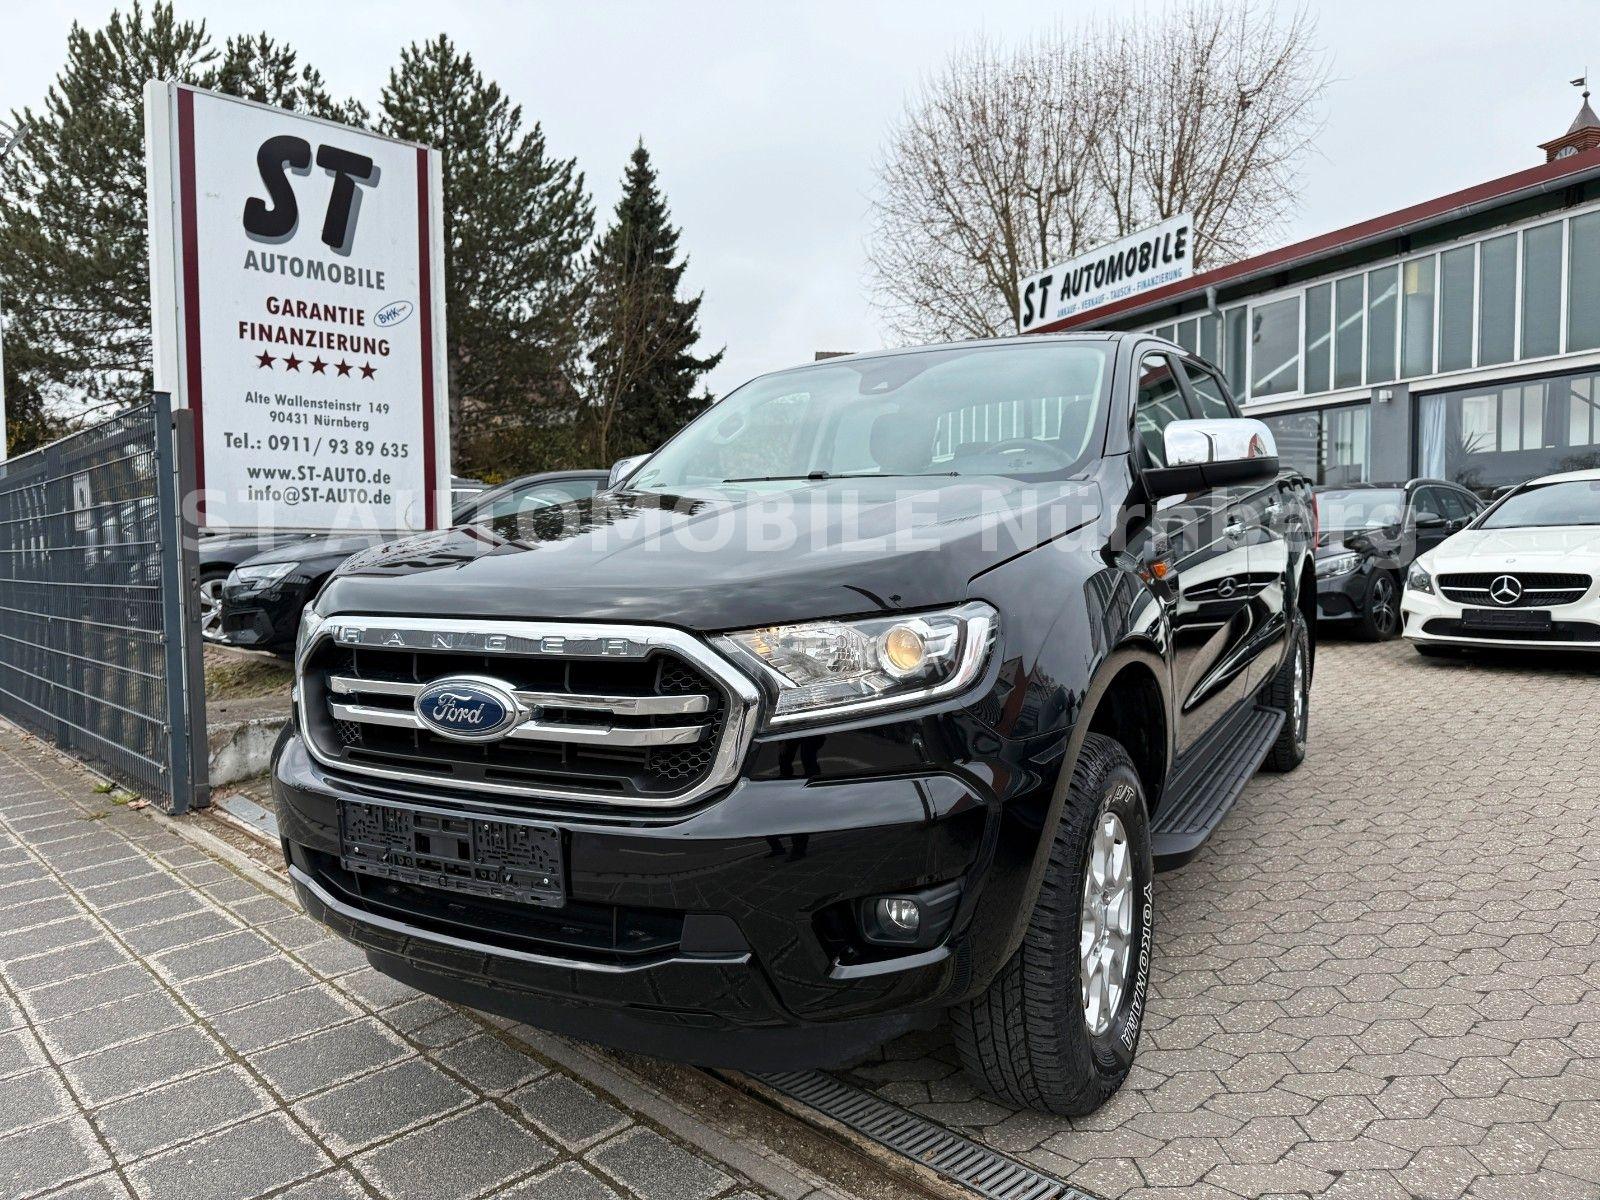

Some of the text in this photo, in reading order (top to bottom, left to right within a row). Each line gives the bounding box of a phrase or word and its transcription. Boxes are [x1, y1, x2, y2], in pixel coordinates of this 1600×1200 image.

[243, 135, 381, 257] ST
[243, 250, 385, 290] AUTOMOBILE
[1023, 226, 1188, 327] ST AUTOMOBILE
[1082, 294, 1104, 309] VERKAUF
[1110, 285, 1131, 300] TAUSCH
[1137, 268, 1182, 290] FINANZIERUNG
[266, 296, 365, 326] GARANTIE
[238, 321, 391, 356] FINANZIERUNG
[245, 391, 389, 414] Alte Wallensteinstr 149
[269, 411, 369, 431] 90431 Nürnberg
[224, 432, 261, 450] Tel.:
[328, 438, 348, 455] 93
[355, 440, 376, 456] 89
[381, 443, 408, 458] 635
[247, 465, 391, 484] www.ST-AUTO.de
[248, 485, 391, 506] info@ST-AUTO.de
[343, 627, 628, 655] RANGER
[433, 692, 484, 725] Ford
[1121, 881, 1153, 1052] YOKOHAMA
